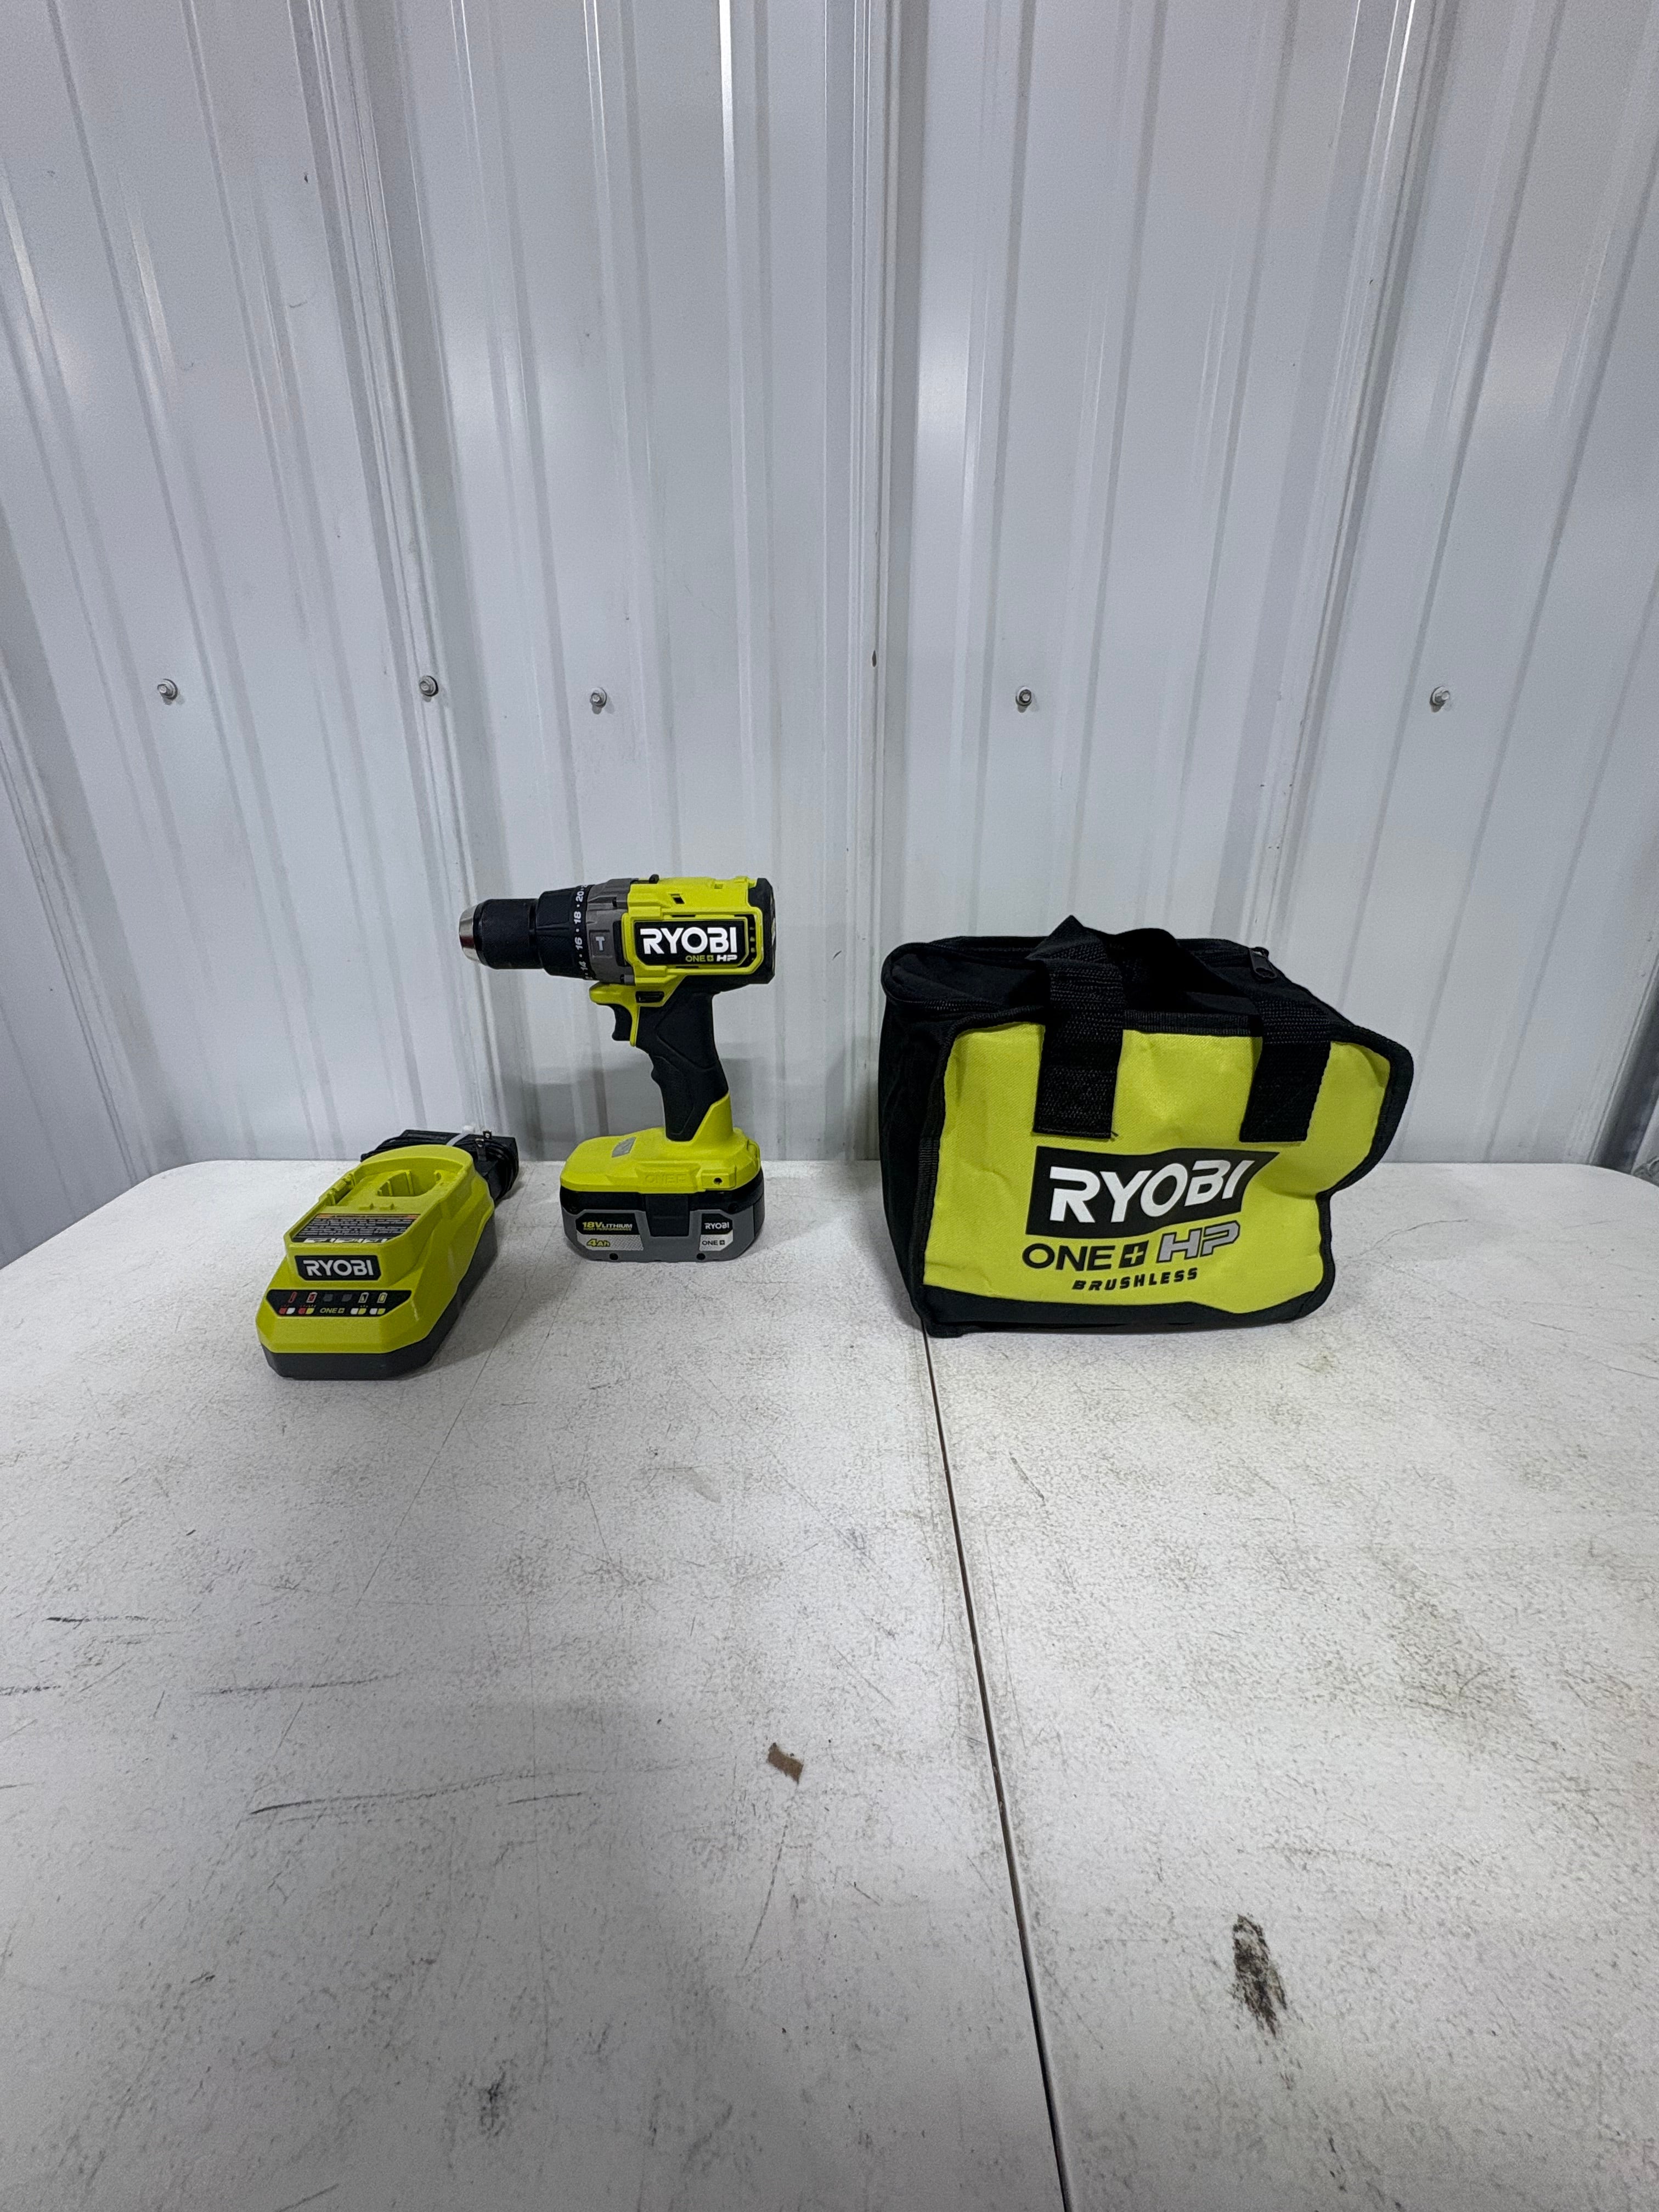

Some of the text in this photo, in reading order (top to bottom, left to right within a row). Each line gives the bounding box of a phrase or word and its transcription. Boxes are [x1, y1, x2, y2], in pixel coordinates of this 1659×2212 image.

[576, 891, 584, 902] 20
[574, 911, 582, 924] 18
[574, 936, 583, 950] 16
[640, 927, 737, 955] RYOBI
[1049, 1159, 1255, 1223] RYOBI
[586, 1239, 611, 1247] 4Ah
[1155, 1220, 1241, 1263] HP
[303, 1260, 374, 1276] RYOBI
[1071, 1267, 1198, 1291] BRUSHLESS
